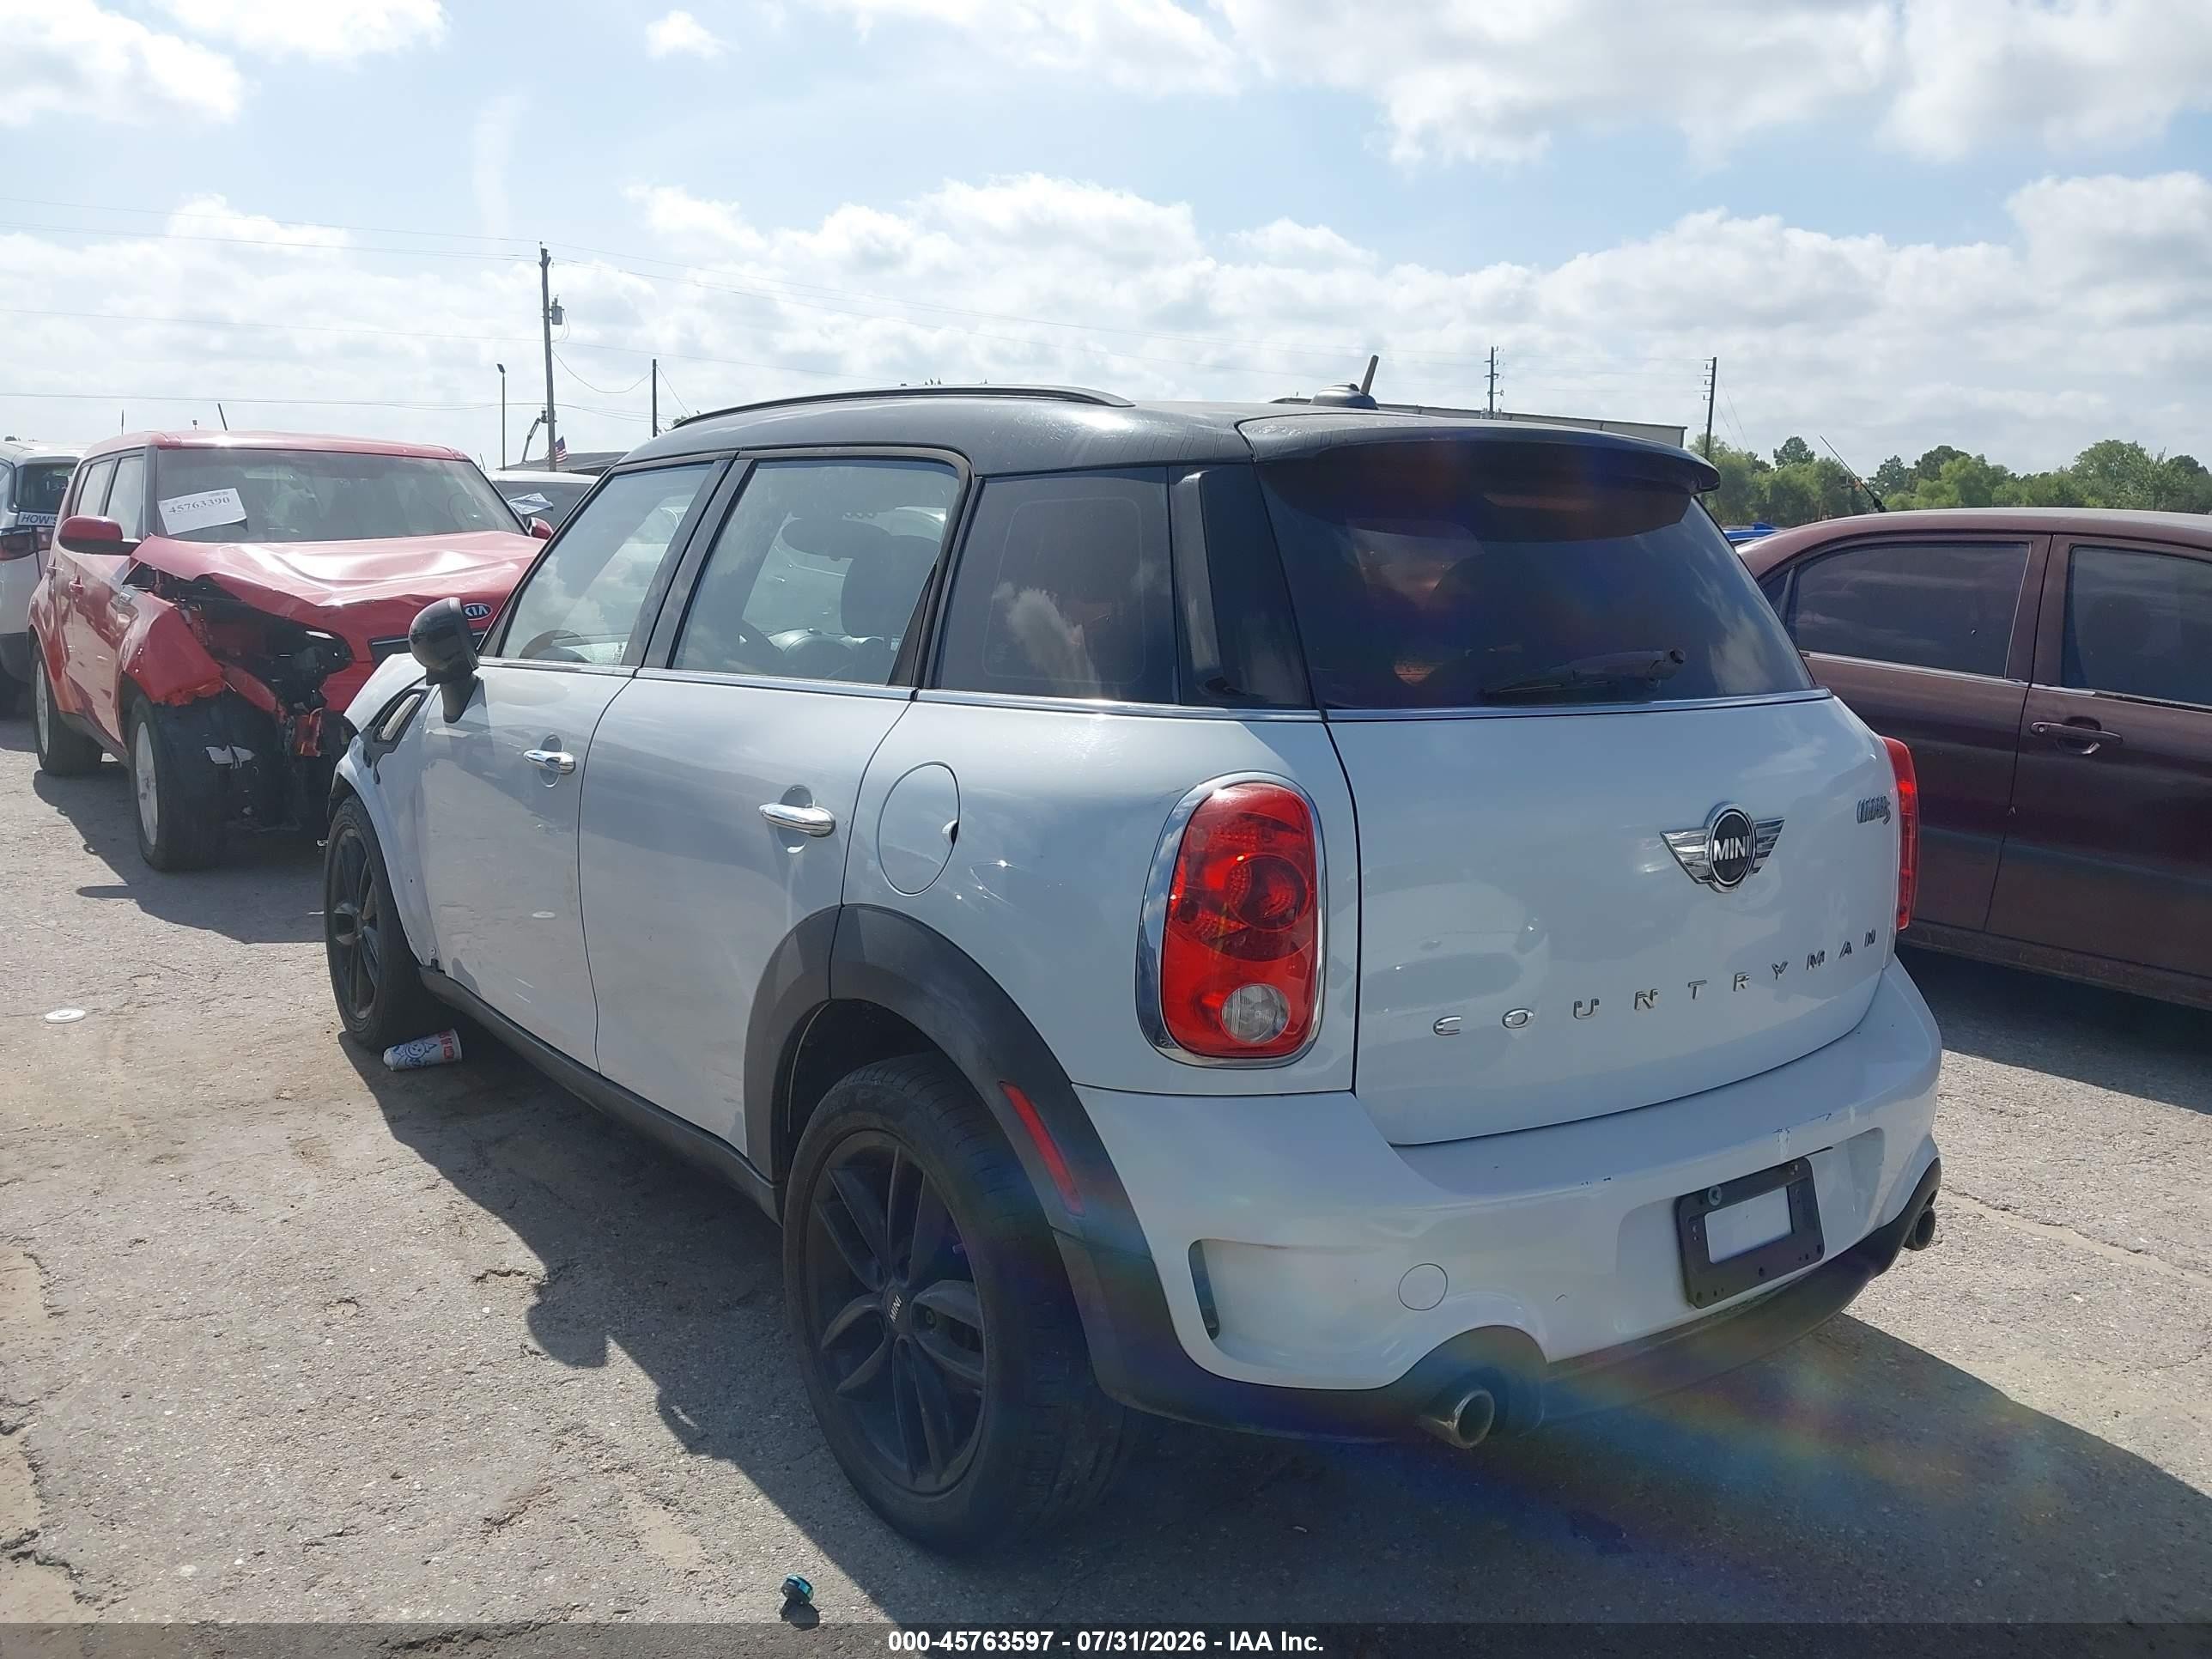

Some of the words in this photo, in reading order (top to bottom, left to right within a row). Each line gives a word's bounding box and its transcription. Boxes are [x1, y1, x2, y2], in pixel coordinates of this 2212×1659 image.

[168, 496, 230, 514] 45763390
[465, 605, 489, 617] KIA
[1713, 836, 1750, 862] MINI
[1432, 929, 1876, 1036] COUNTRYMAN
